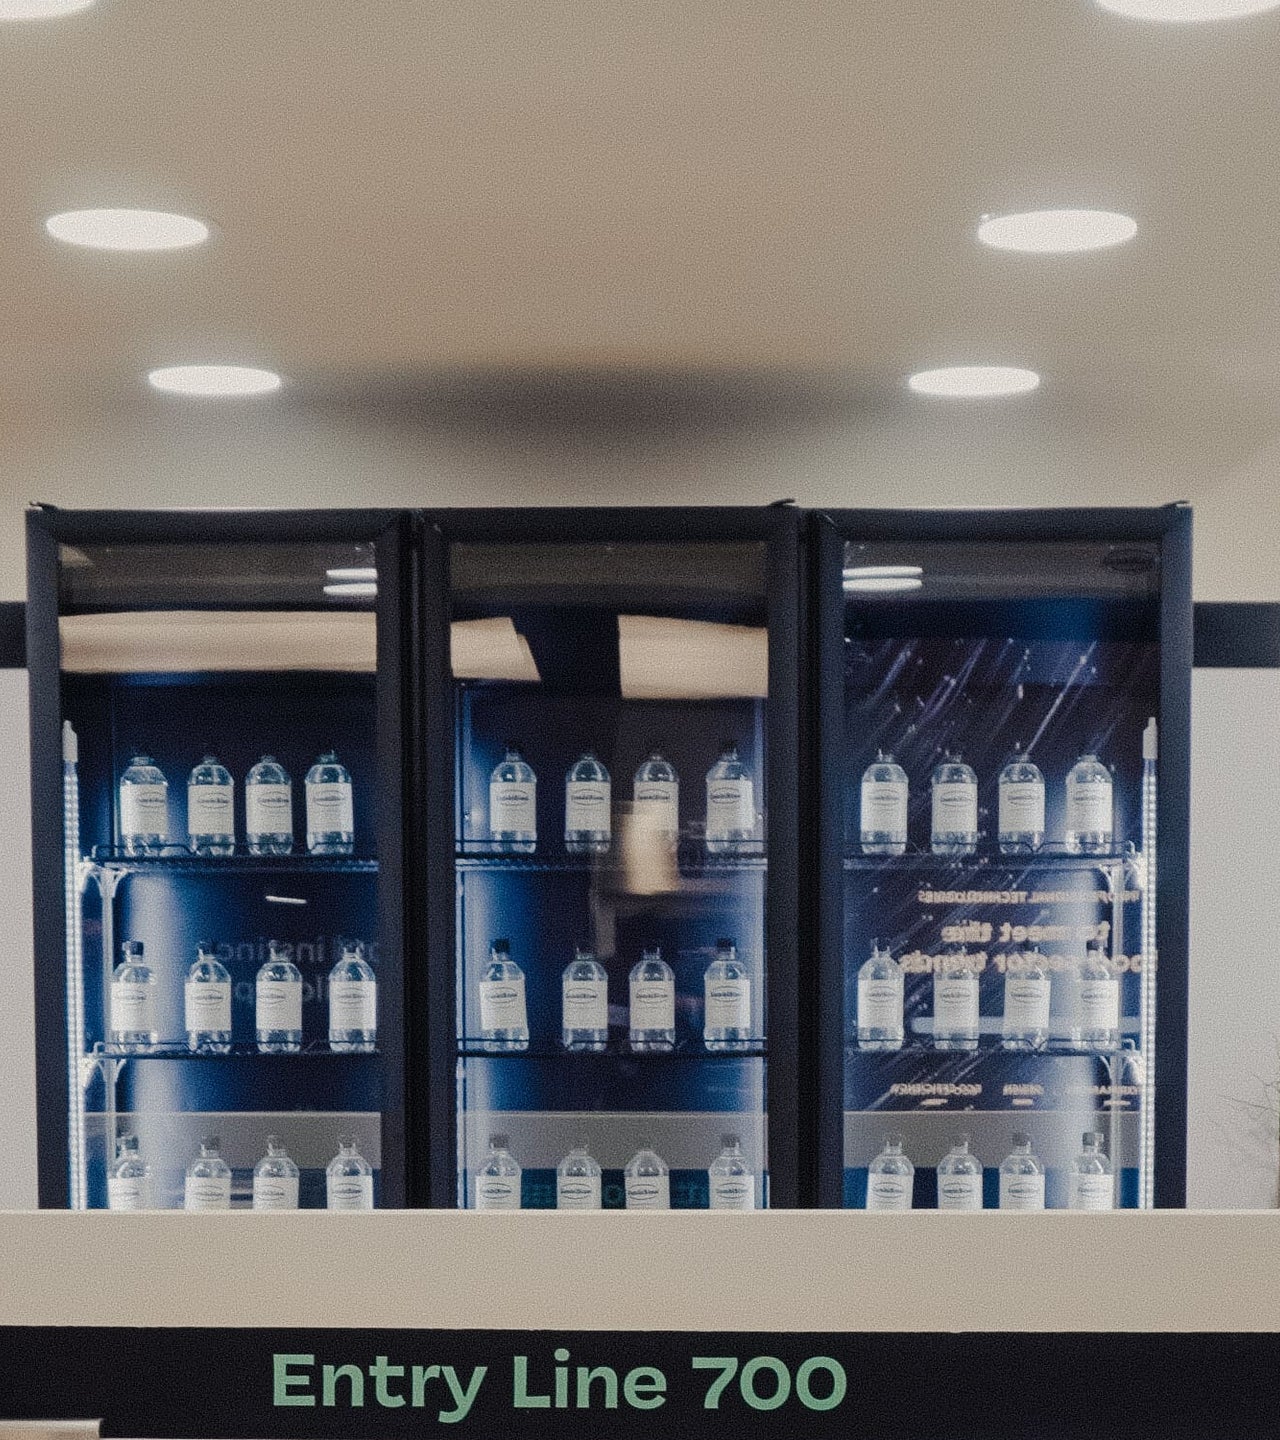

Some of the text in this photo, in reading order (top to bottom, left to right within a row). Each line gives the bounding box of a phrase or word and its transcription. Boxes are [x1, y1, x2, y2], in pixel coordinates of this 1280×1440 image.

[272, 1348, 847, 1424] Entry Line 700
